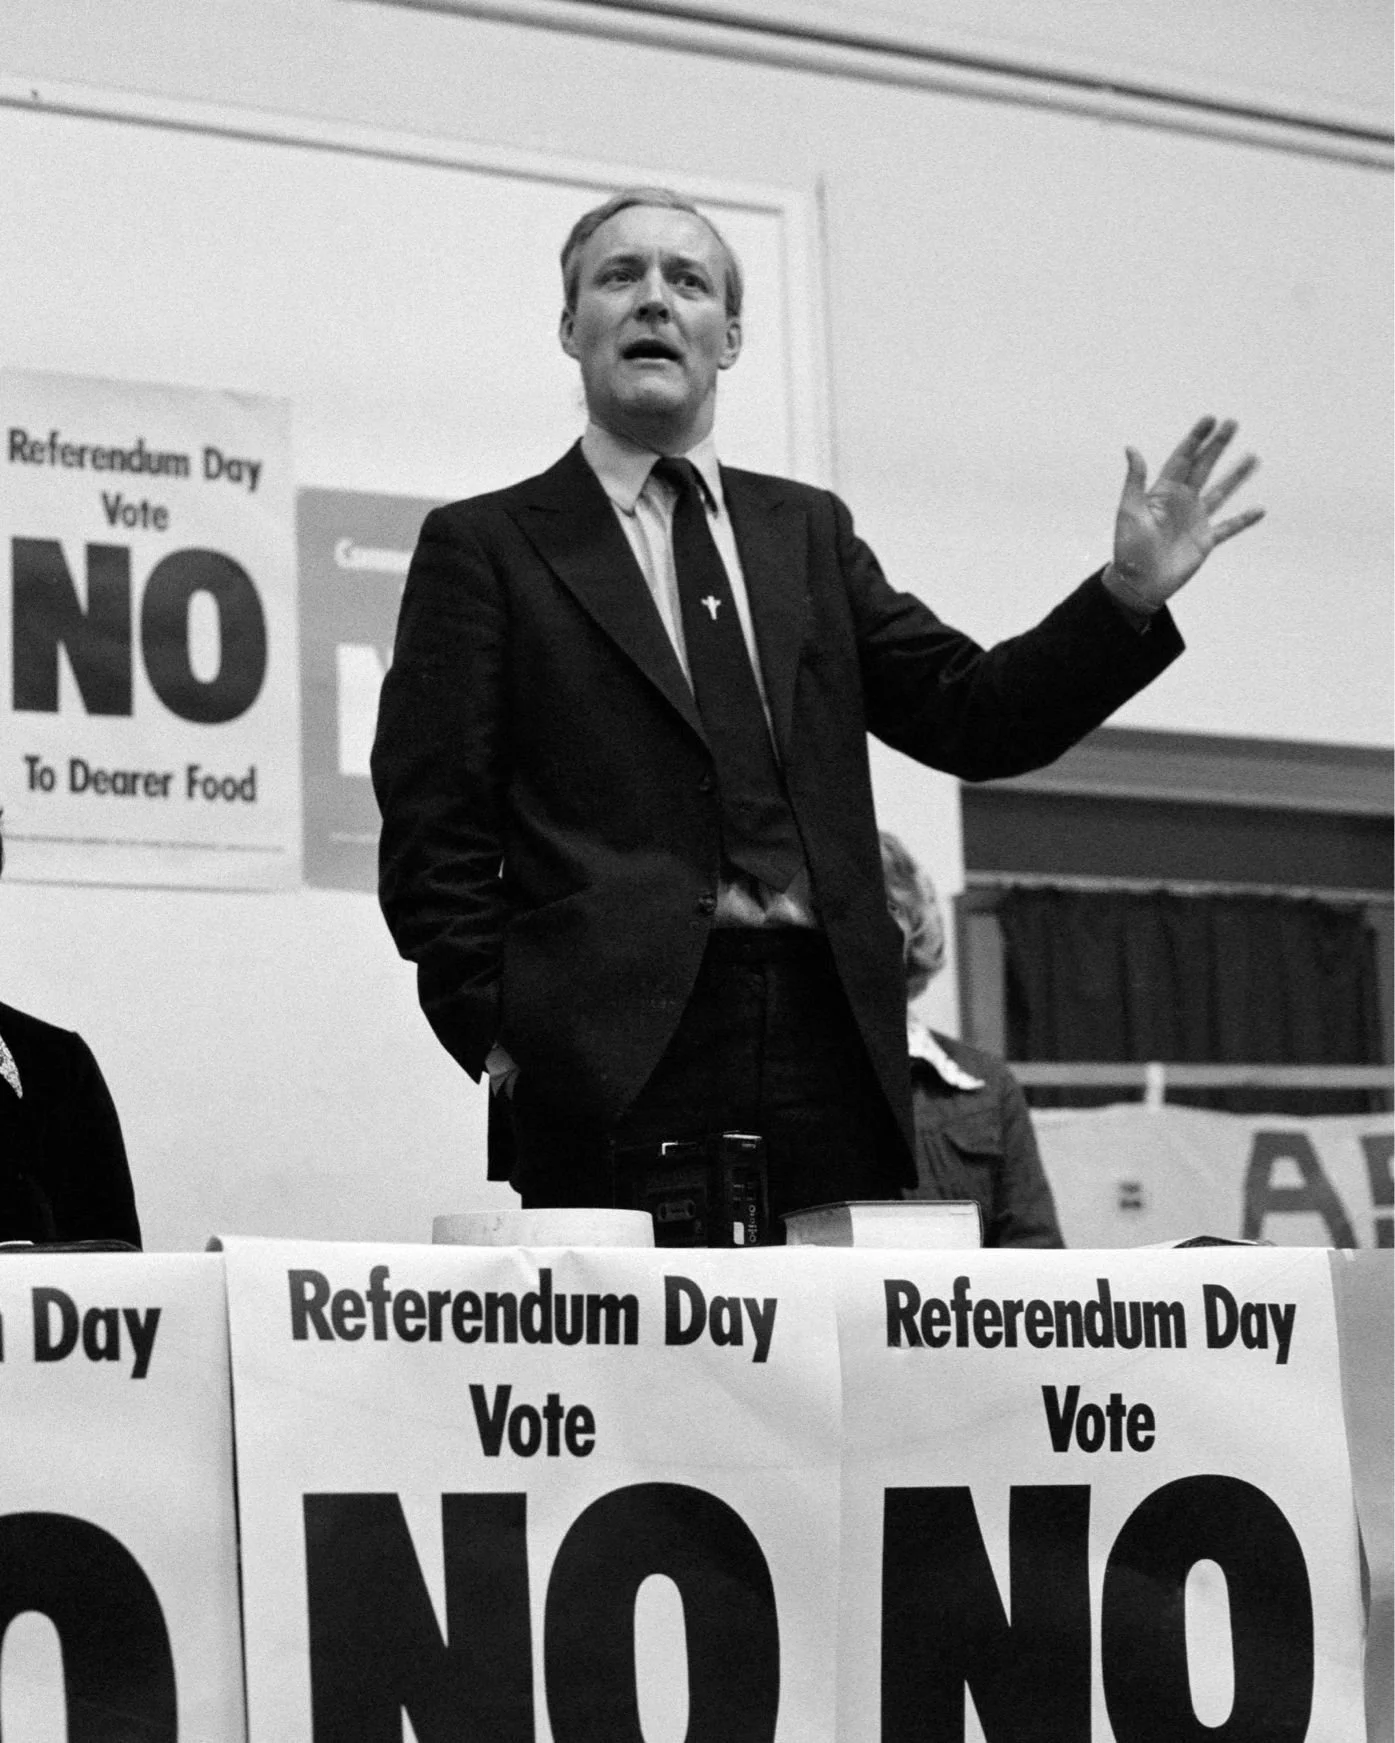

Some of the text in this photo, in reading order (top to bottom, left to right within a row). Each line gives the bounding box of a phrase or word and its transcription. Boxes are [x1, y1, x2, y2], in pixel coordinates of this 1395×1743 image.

[9, 428, 261, 492] Referendum Day
[102, 492, 169, 531] Vote
[11, 536, 268, 726] NO
[24, 754, 258, 803] To Dearer Food
[32, 1287, 162, 1379] Day
[288, 1265, 778, 1364] Referendum Day
[884, 1276, 1297, 1365] Referendum Day
[468, 1383, 596, 1458] Vote
[1041, 1385, 1156, 1454] Vote
[302, 1481, 781, 1743] NO
[880, 1473, 1315, 1743] NO
